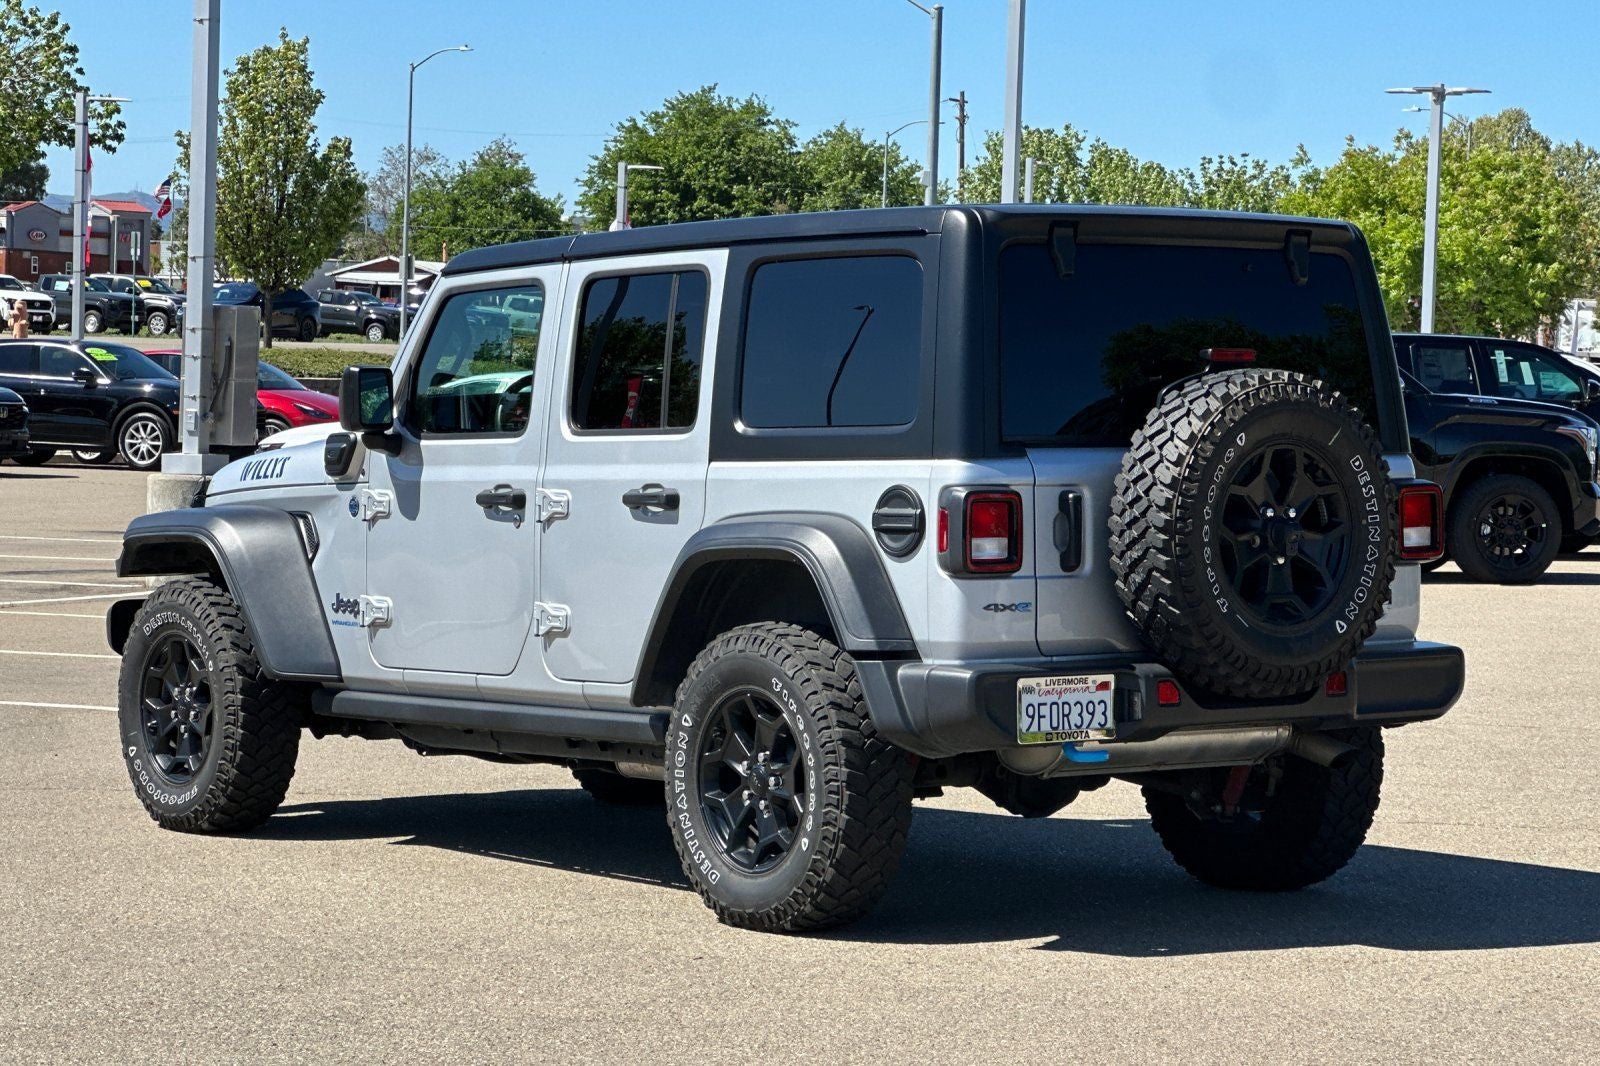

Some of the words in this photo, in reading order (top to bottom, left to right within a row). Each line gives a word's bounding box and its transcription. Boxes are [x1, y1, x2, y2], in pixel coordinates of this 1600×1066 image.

[240, 456, 291, 481] WILLYS
[1346, 455, 1380, 620] DESTINATION
[332, 593, 360, 619] Jeep
[1022, 686, 1036, 695] MAR
[1038, 685, 1091, 700] California
[1045, 677, 1089, 687] LIVERMORE
[1025, 699, 1109, 733] 9FOR393
[1055, 730, 1091, 741] TOYOTA
[675, 732, 720, 884] DESTINATION
